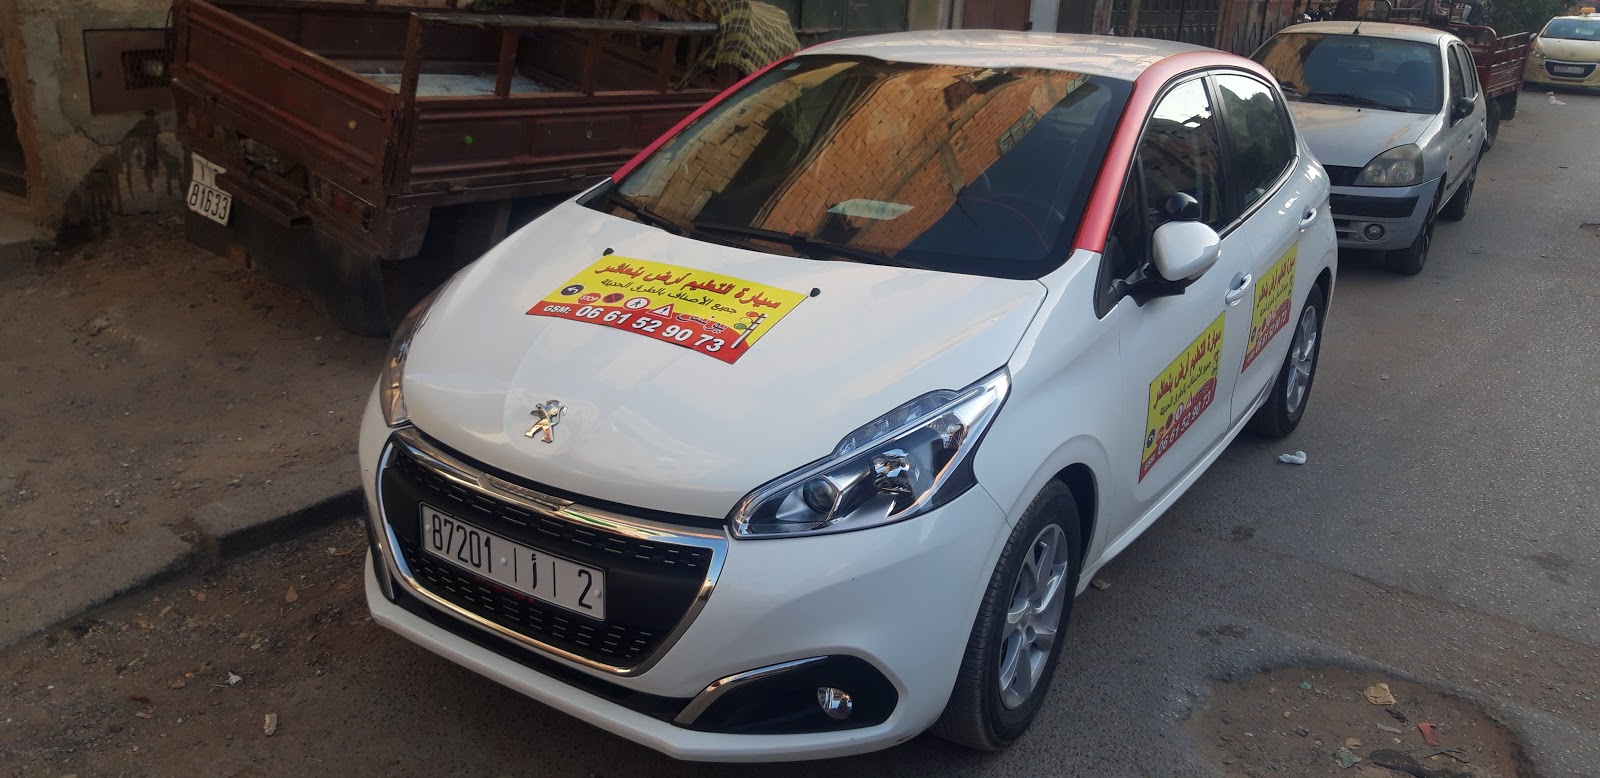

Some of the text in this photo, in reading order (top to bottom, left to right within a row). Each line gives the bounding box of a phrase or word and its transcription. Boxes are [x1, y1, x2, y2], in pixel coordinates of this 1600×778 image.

[189, 183, 229, 220] 81633
[580, 294, 600, 302] STOP
[711, 302, 737, 315] جميع
[733, 287, 782, 309] سيارة
[543, 304, 725, 352] GSM: 06 61 52 90 73
[432, 513, 493, 574] 87201
[577, 568, 594, 610] 2
